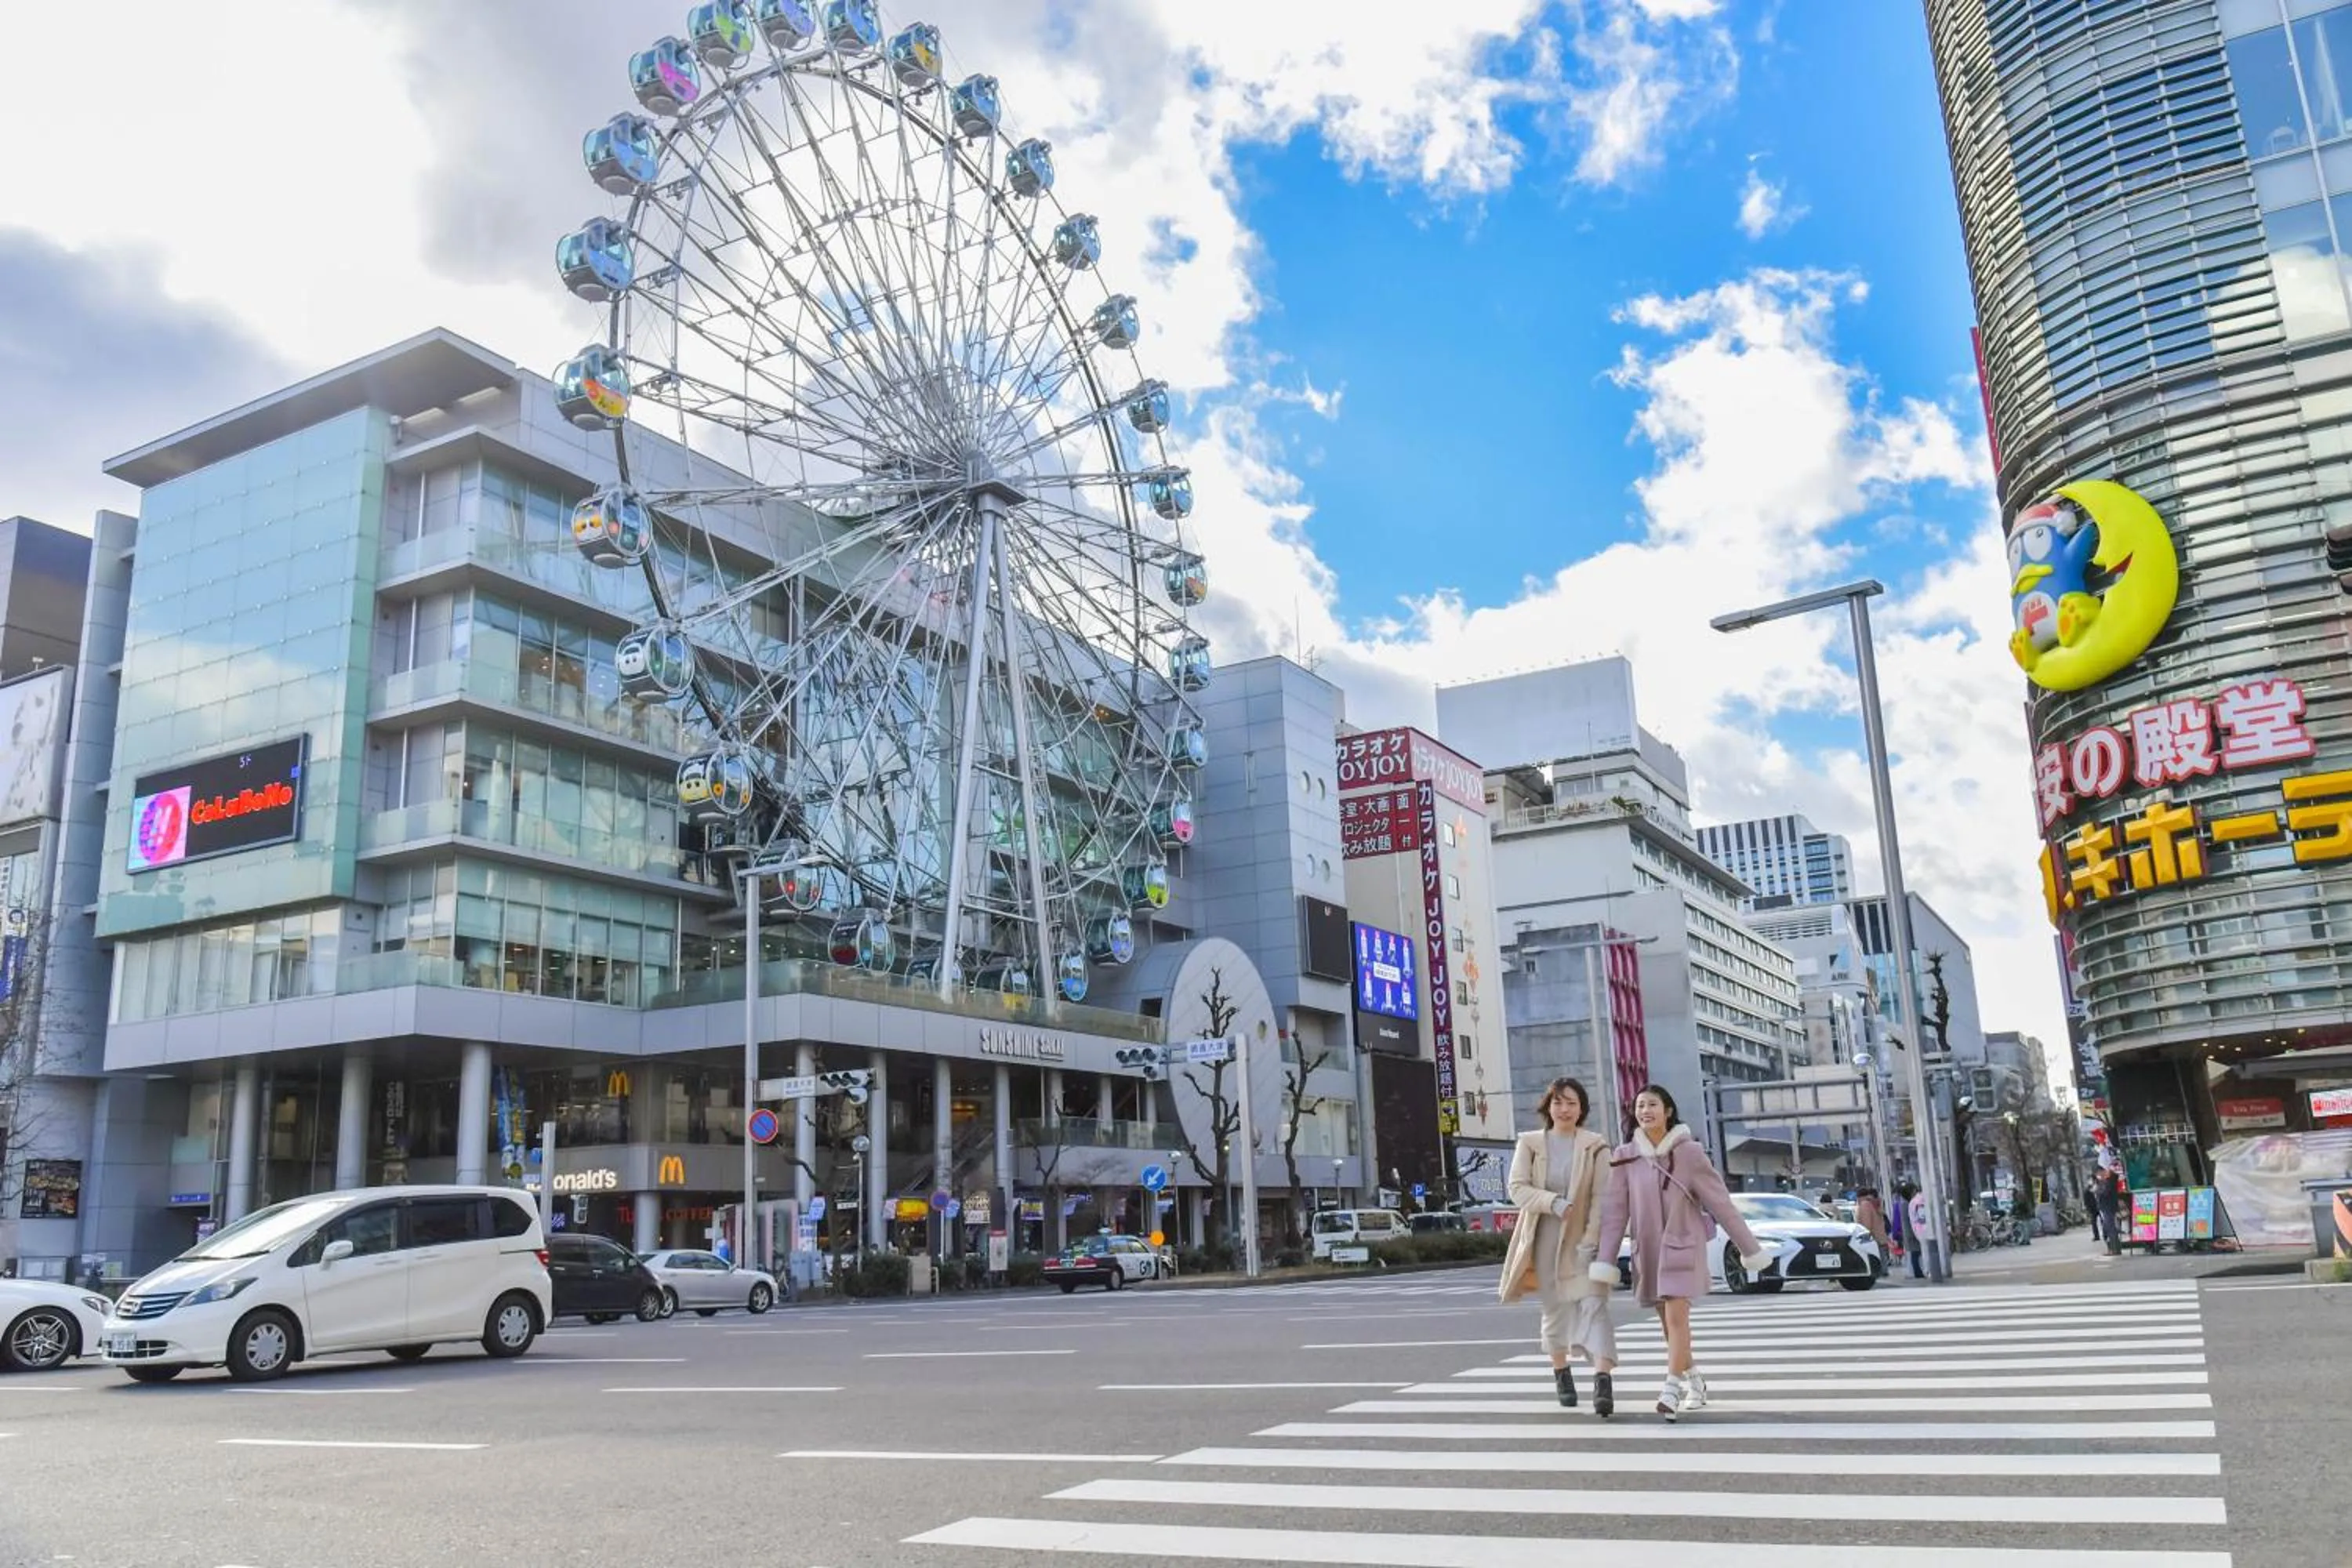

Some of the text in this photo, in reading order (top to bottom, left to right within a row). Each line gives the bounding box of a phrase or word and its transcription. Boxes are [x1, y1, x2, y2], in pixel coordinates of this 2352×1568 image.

[1336, 734, 1406, 760] カラオケ
[1341, 816, 1411, 836] ロジェクター
[1418, 782, 1438, 891] カラオケ
[2038, 768, 2352, 927] ・キホーテ
[979, 1027, 1040, 1058] SUNSHINE
[526, 1169, 617, 1190] onald's
